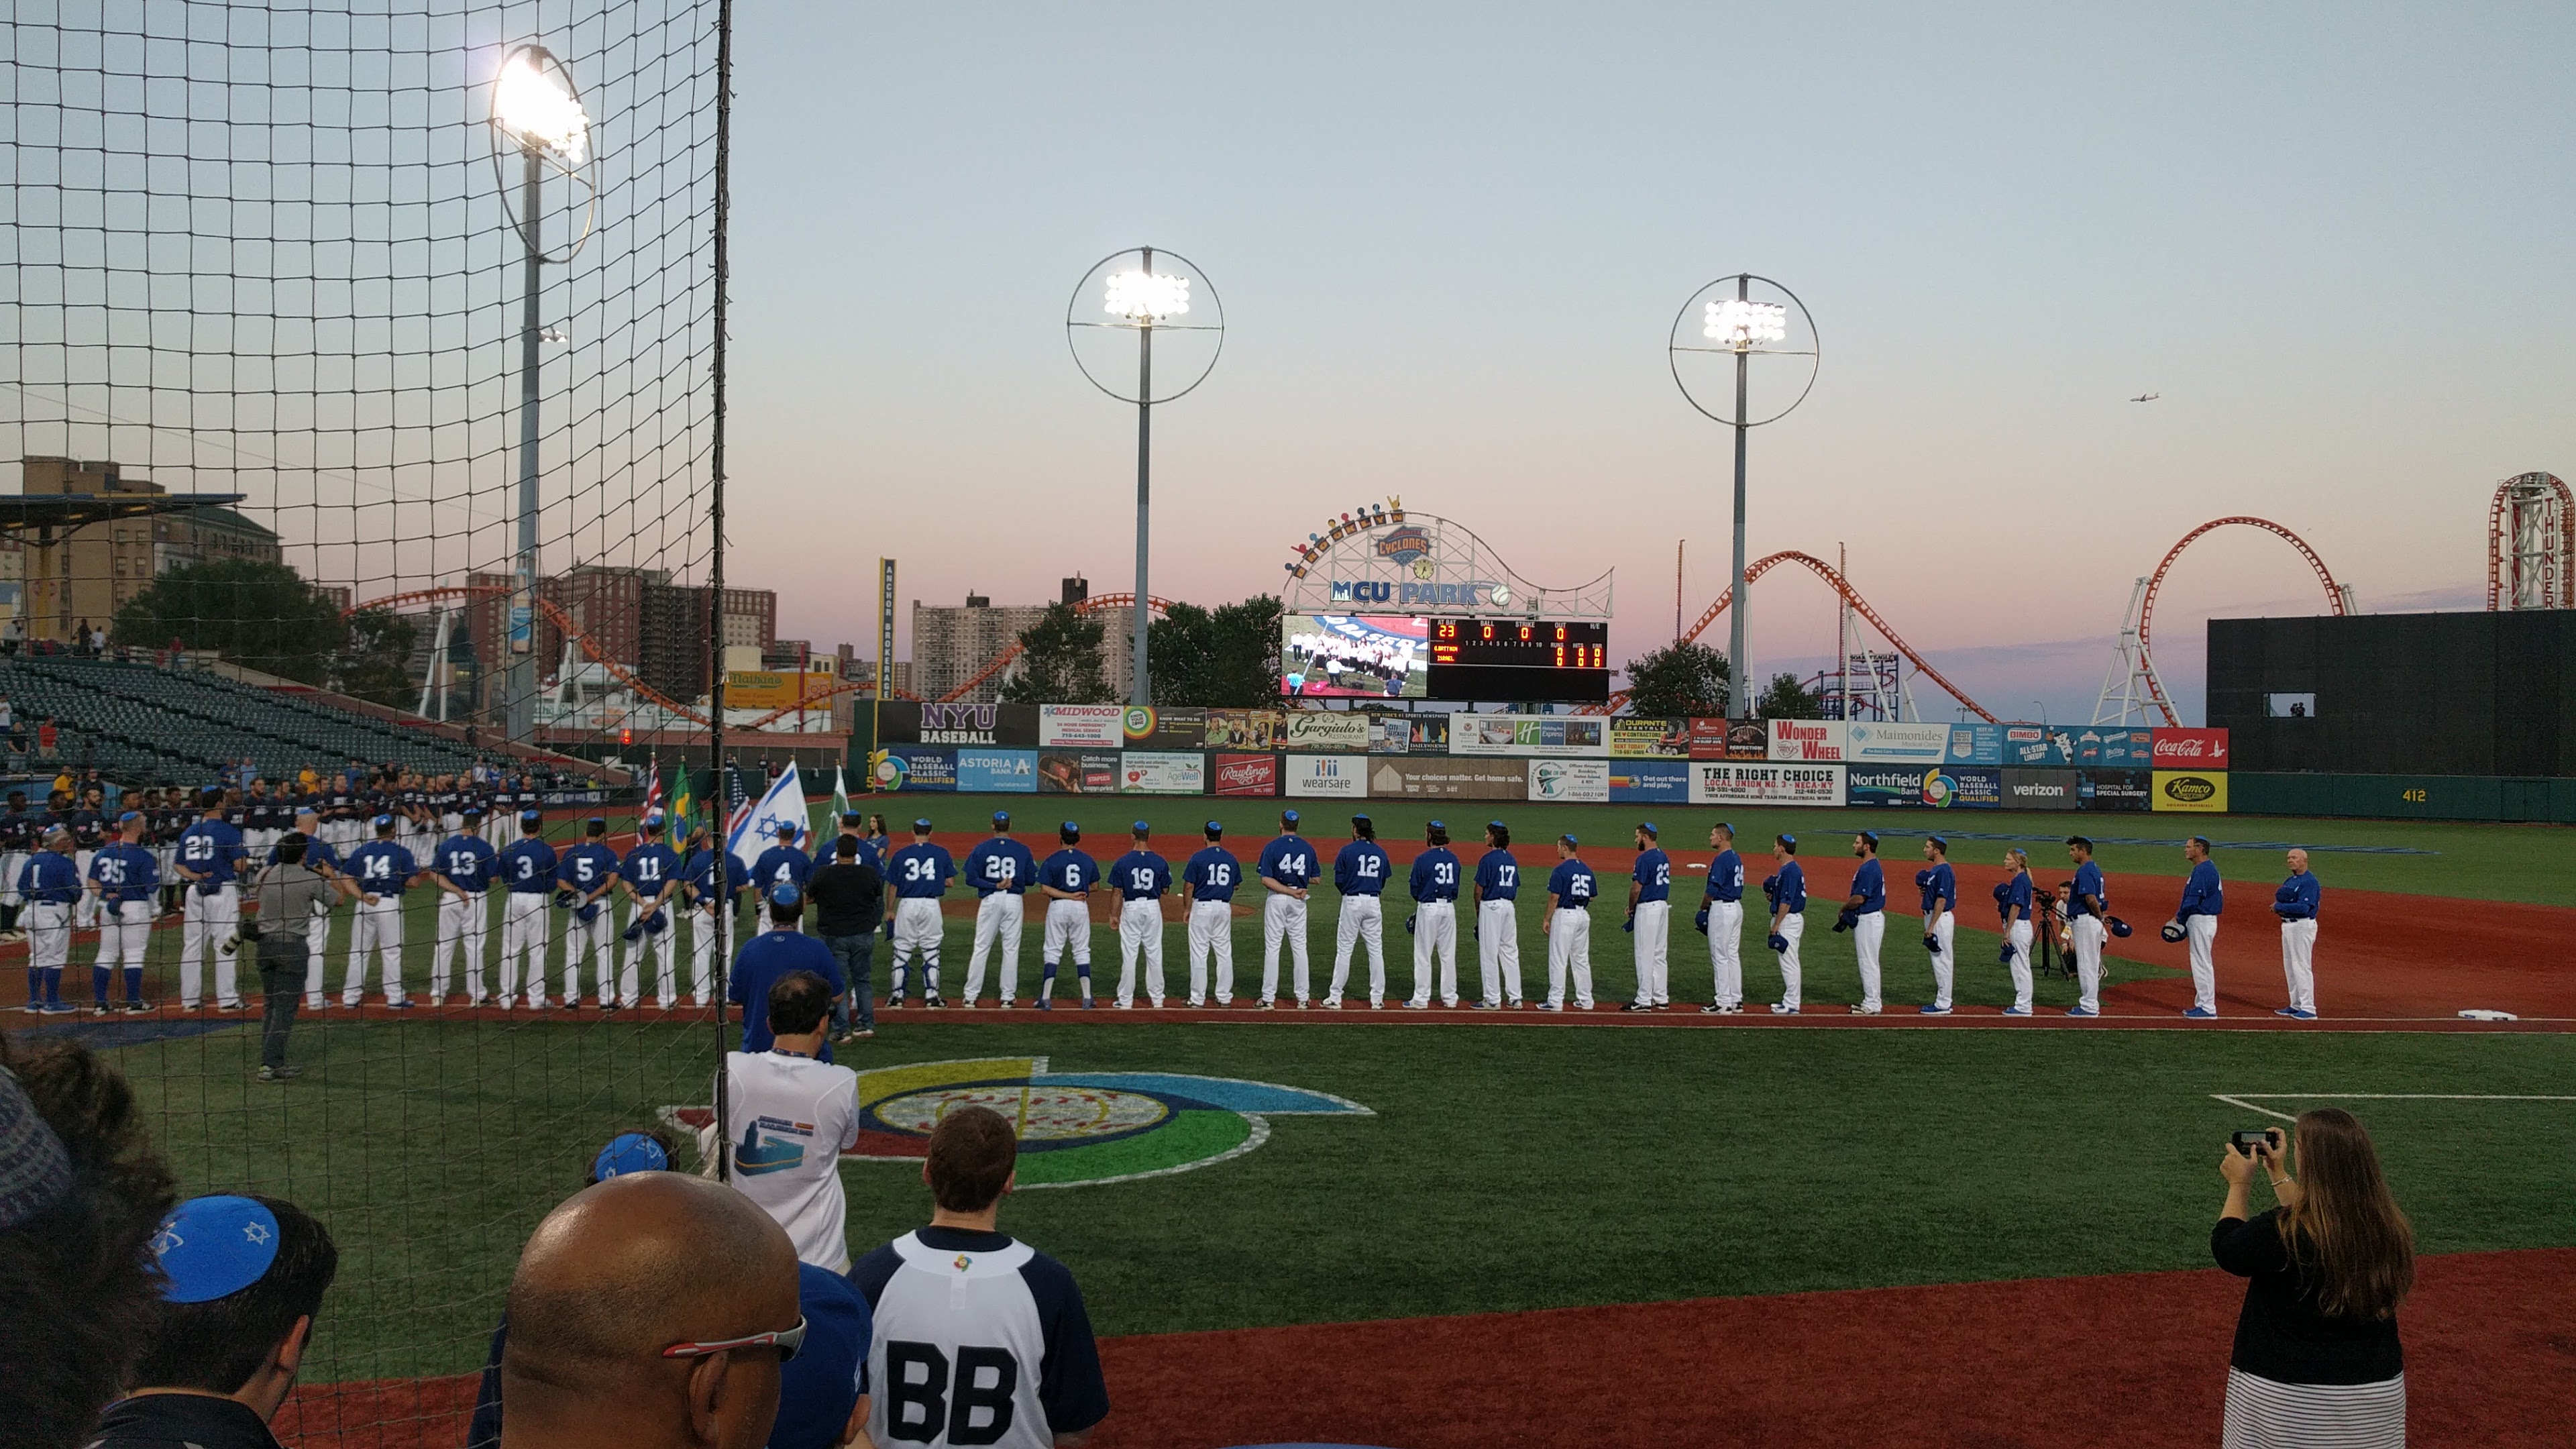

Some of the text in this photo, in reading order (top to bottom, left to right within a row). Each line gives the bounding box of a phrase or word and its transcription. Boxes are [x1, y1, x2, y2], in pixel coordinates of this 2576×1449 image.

[1296, 514, 1403, 578] BROOKLYN
[1379, 537, 1428, 555] CYCLONES
[2545, 497, 2555, 609] THUNDER
[1331, 580, 1481, 604] MCU PARK
[1439, 625, 1454, 637] 23
[1483, 626, 1491, 638] 0
[1521, 627, 1529, 639] 0
[1556, 628, 1564, 640] 0
[883, 623, 892, 698] BROKERAGE
[1557, 647, 1601, 657] 0 0 0
[1557, 657, 1562, 666] 0
[1578, 657, 1584, 667] 0
[1594, 658, 1600, 667] 0
[731, 673, 784, 685] Nathan's
[921, 703, 998, 729] NYU
[1055, 706, 1120, 716] MIDWOOD
[1289, 716, 1366, 738] Gargiulo's
[1776, 721, 1827, 740] WONDER
[1876, 729, 1943, 741] Maimonides
[2010, 731, 2040, 739] BIMBO
[920, 731, 996, 744] BASEBALL
[1802, 741, 1841, 759] WHEEL
[2020, 743, 2048, 755] ALL-STAR
[2024, 753, 2045, 761] LINEUP!
[2154, 739, 2206, 757] Coca-Cola
[959, 758, 1012, 767] ASTORIA
[1167, 772, 1198, 782] AgeWell
[1220, 764, 1271, 781] Rawlings
[1703, 768, 1833, 781] THE RIGHT CHOICE
[1850, 773, 1921, 788] Northfield
[1303, 779, 1350, 789] wearsafe
[1655, 782, 1672, 790] play.
[1900, 788, 1920, 796] Bank
[2012, 783, 2064, 796] verizon
[2171, 778, 2211, 794] Kamco
[2402, 790, 2426, 802] 412
[184, 835, 215, 860] 20
[97, 857, 128, 884] 35
[363, 855, 390, 879] 14
[449, 851, 476, 875] 13
[517, 855, 533, 879] 3
[577, 857, 594, 881] 5
[638, 857, 661, 881] 11
[775, 861, 792, 881] 4
[904, 857, 936, 881] 34
[985, 855, 1016, 879] 28
[1278, 853, 1306, 875] 44
[1358, 855, 1381, 877] 12
[1065, 865, 1081, 887] 6
[1131, 867, 1155, 890] 19
[1207, 863, 1230, 885] 16
[1434, 863, 1454, 884] 31
[1499, 864, 1515, 888] 17
[1656, 863, 1670, 886] 23
[1571, 873, 1590, 897] 25
[886, 1340, 1018, 1445] BB
